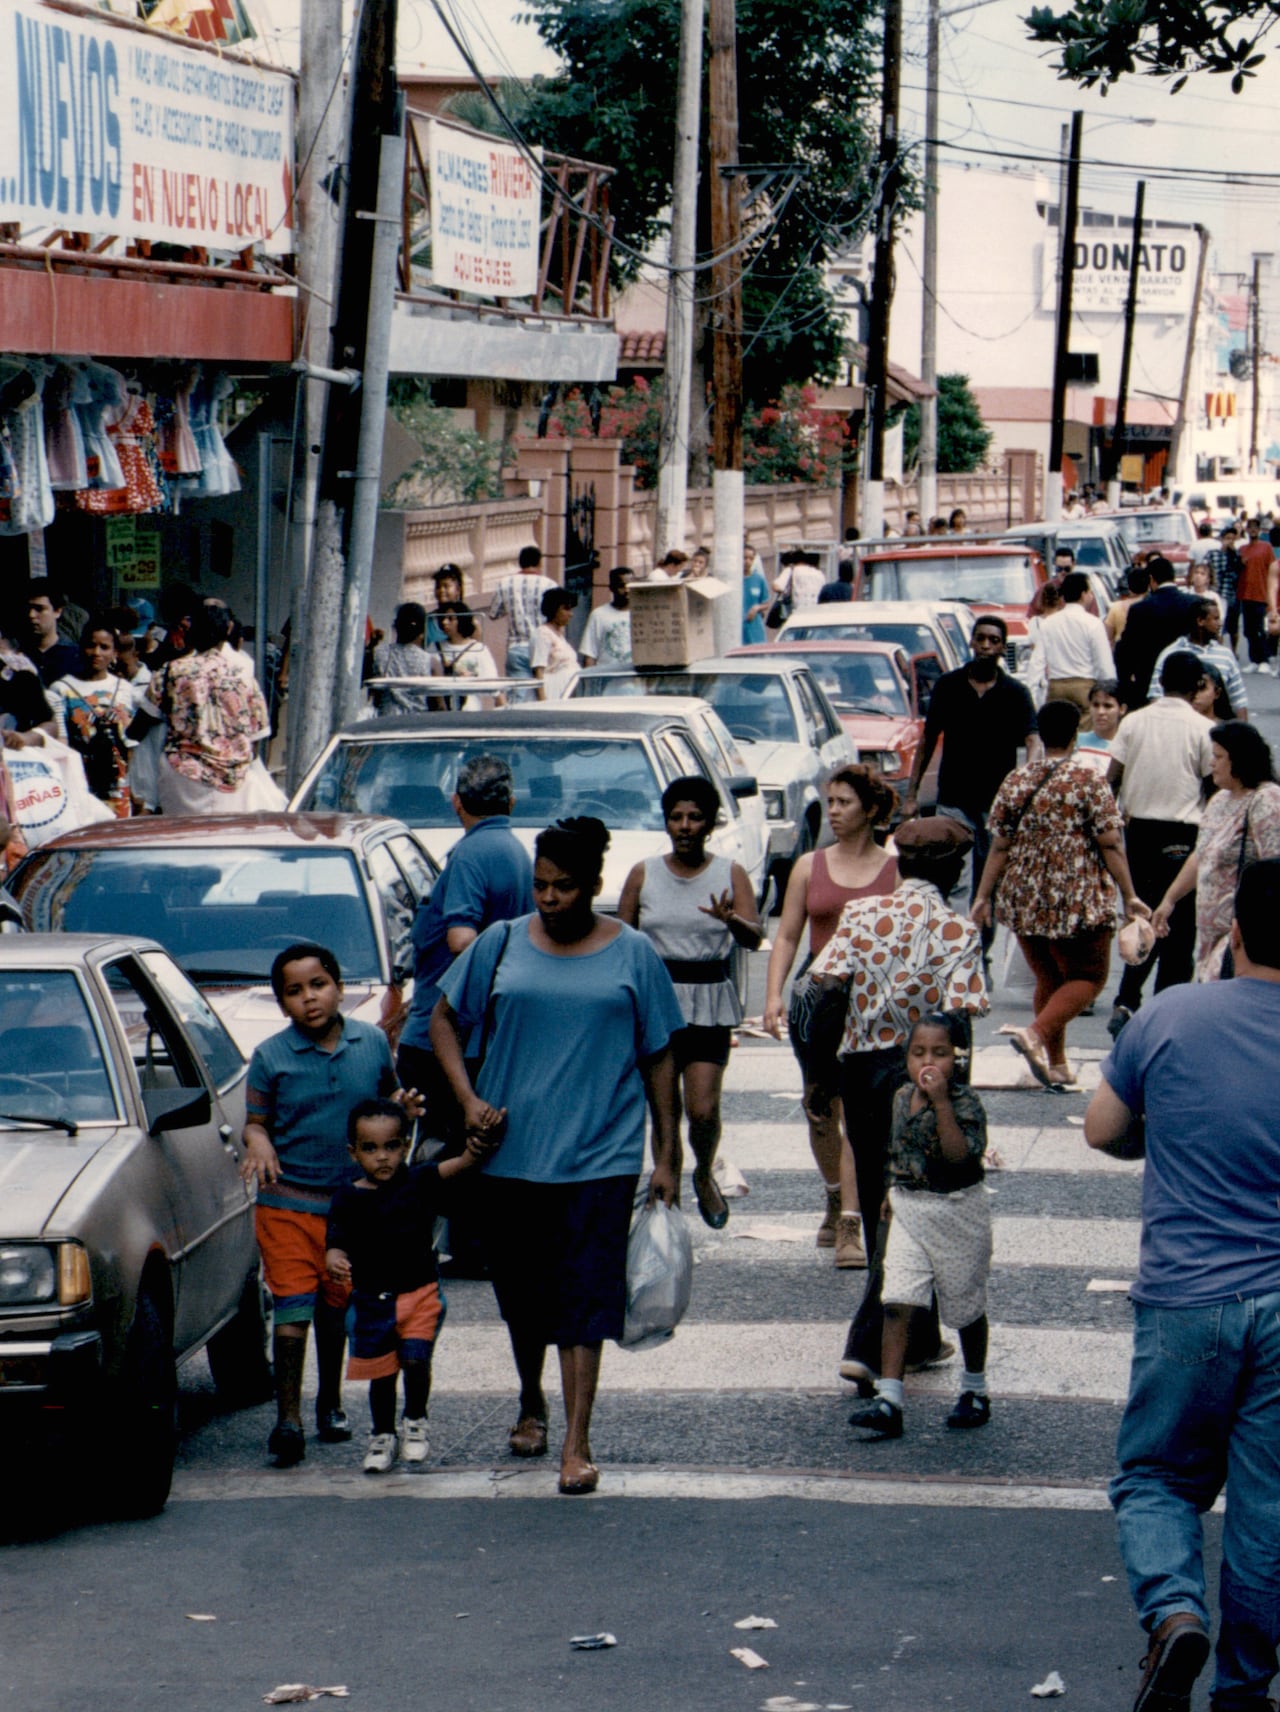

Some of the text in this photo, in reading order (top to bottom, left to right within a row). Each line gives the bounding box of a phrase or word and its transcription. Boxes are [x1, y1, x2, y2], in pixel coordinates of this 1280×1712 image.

[437, 149, 533, 200] ALMACENES RIVIERA
[132, 162, 273, 240] EN NUEVO LOCAL
[1074, 242, 1186, 273] DONATO
[1140, 275, 1182, 286] BARATO
